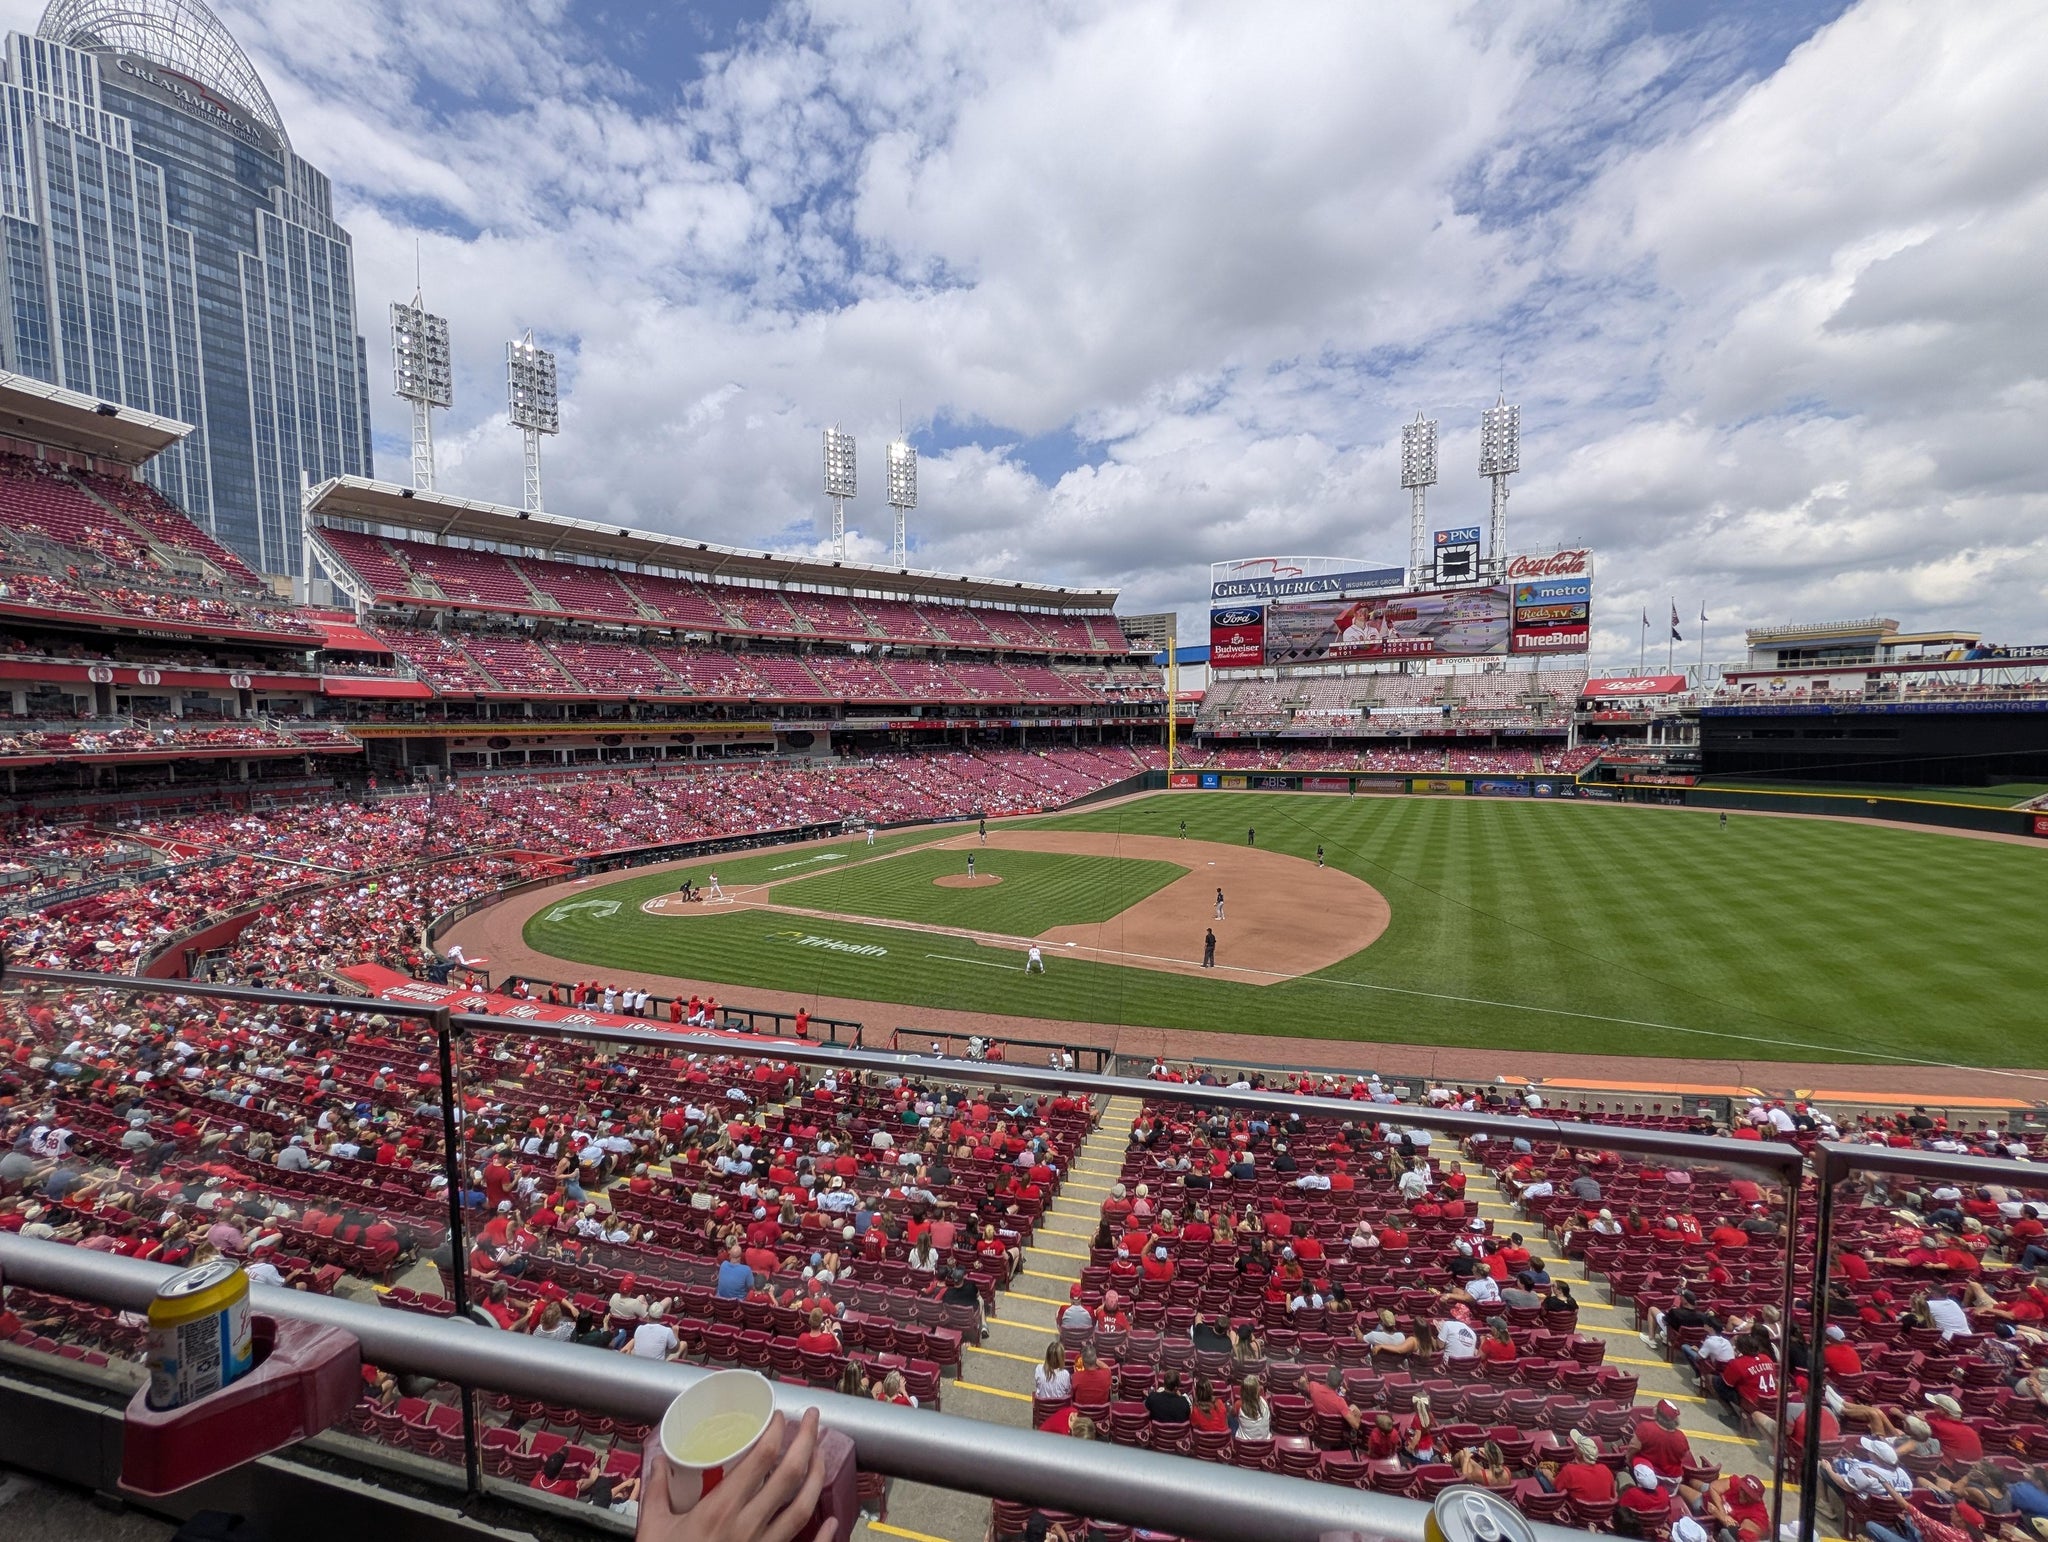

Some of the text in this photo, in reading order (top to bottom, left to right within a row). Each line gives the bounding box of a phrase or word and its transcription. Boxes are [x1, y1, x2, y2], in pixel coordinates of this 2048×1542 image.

[115, 58, 263, 140] GREAT AMERICAN
[176, 100, 231, 131] INSURANCE
[1450, 528, 1479, 541] PNC
[1508, 549, 1590, 579] Coca-Cola
[1214, 578, 1341, 597] GREAT AMERICAN
[1345, 577, 1401, 589] INSURANCE GROUP
[1540, 585, 1587, 598] metro
[1222, 611, 1251, 624] Ford
[152, 630, 175, 639] PRESS
[175, 632, 193, 640] CLUB
[1515, 631, 1588, 648] ThreeBond
[1214, 644, 1260, 654] Budweiser
[93, 668, 109, 683] 13
[142, 671, 157, 685] 11
[233, 675, 249, 688] 14
[1601, 680, 1657, 691] Reds
[1864, 702, 2040, 714] 529 COLLEGE ADVANTAGE
[797, 935, 888, 957] TriHealth
[506, 1005, 540, 1017] 1940
[46, 1137, 60, 1150] 38
[1683, 1222, 1697, 1234] 54
[1759, 1374, 1776, 1393] 44
